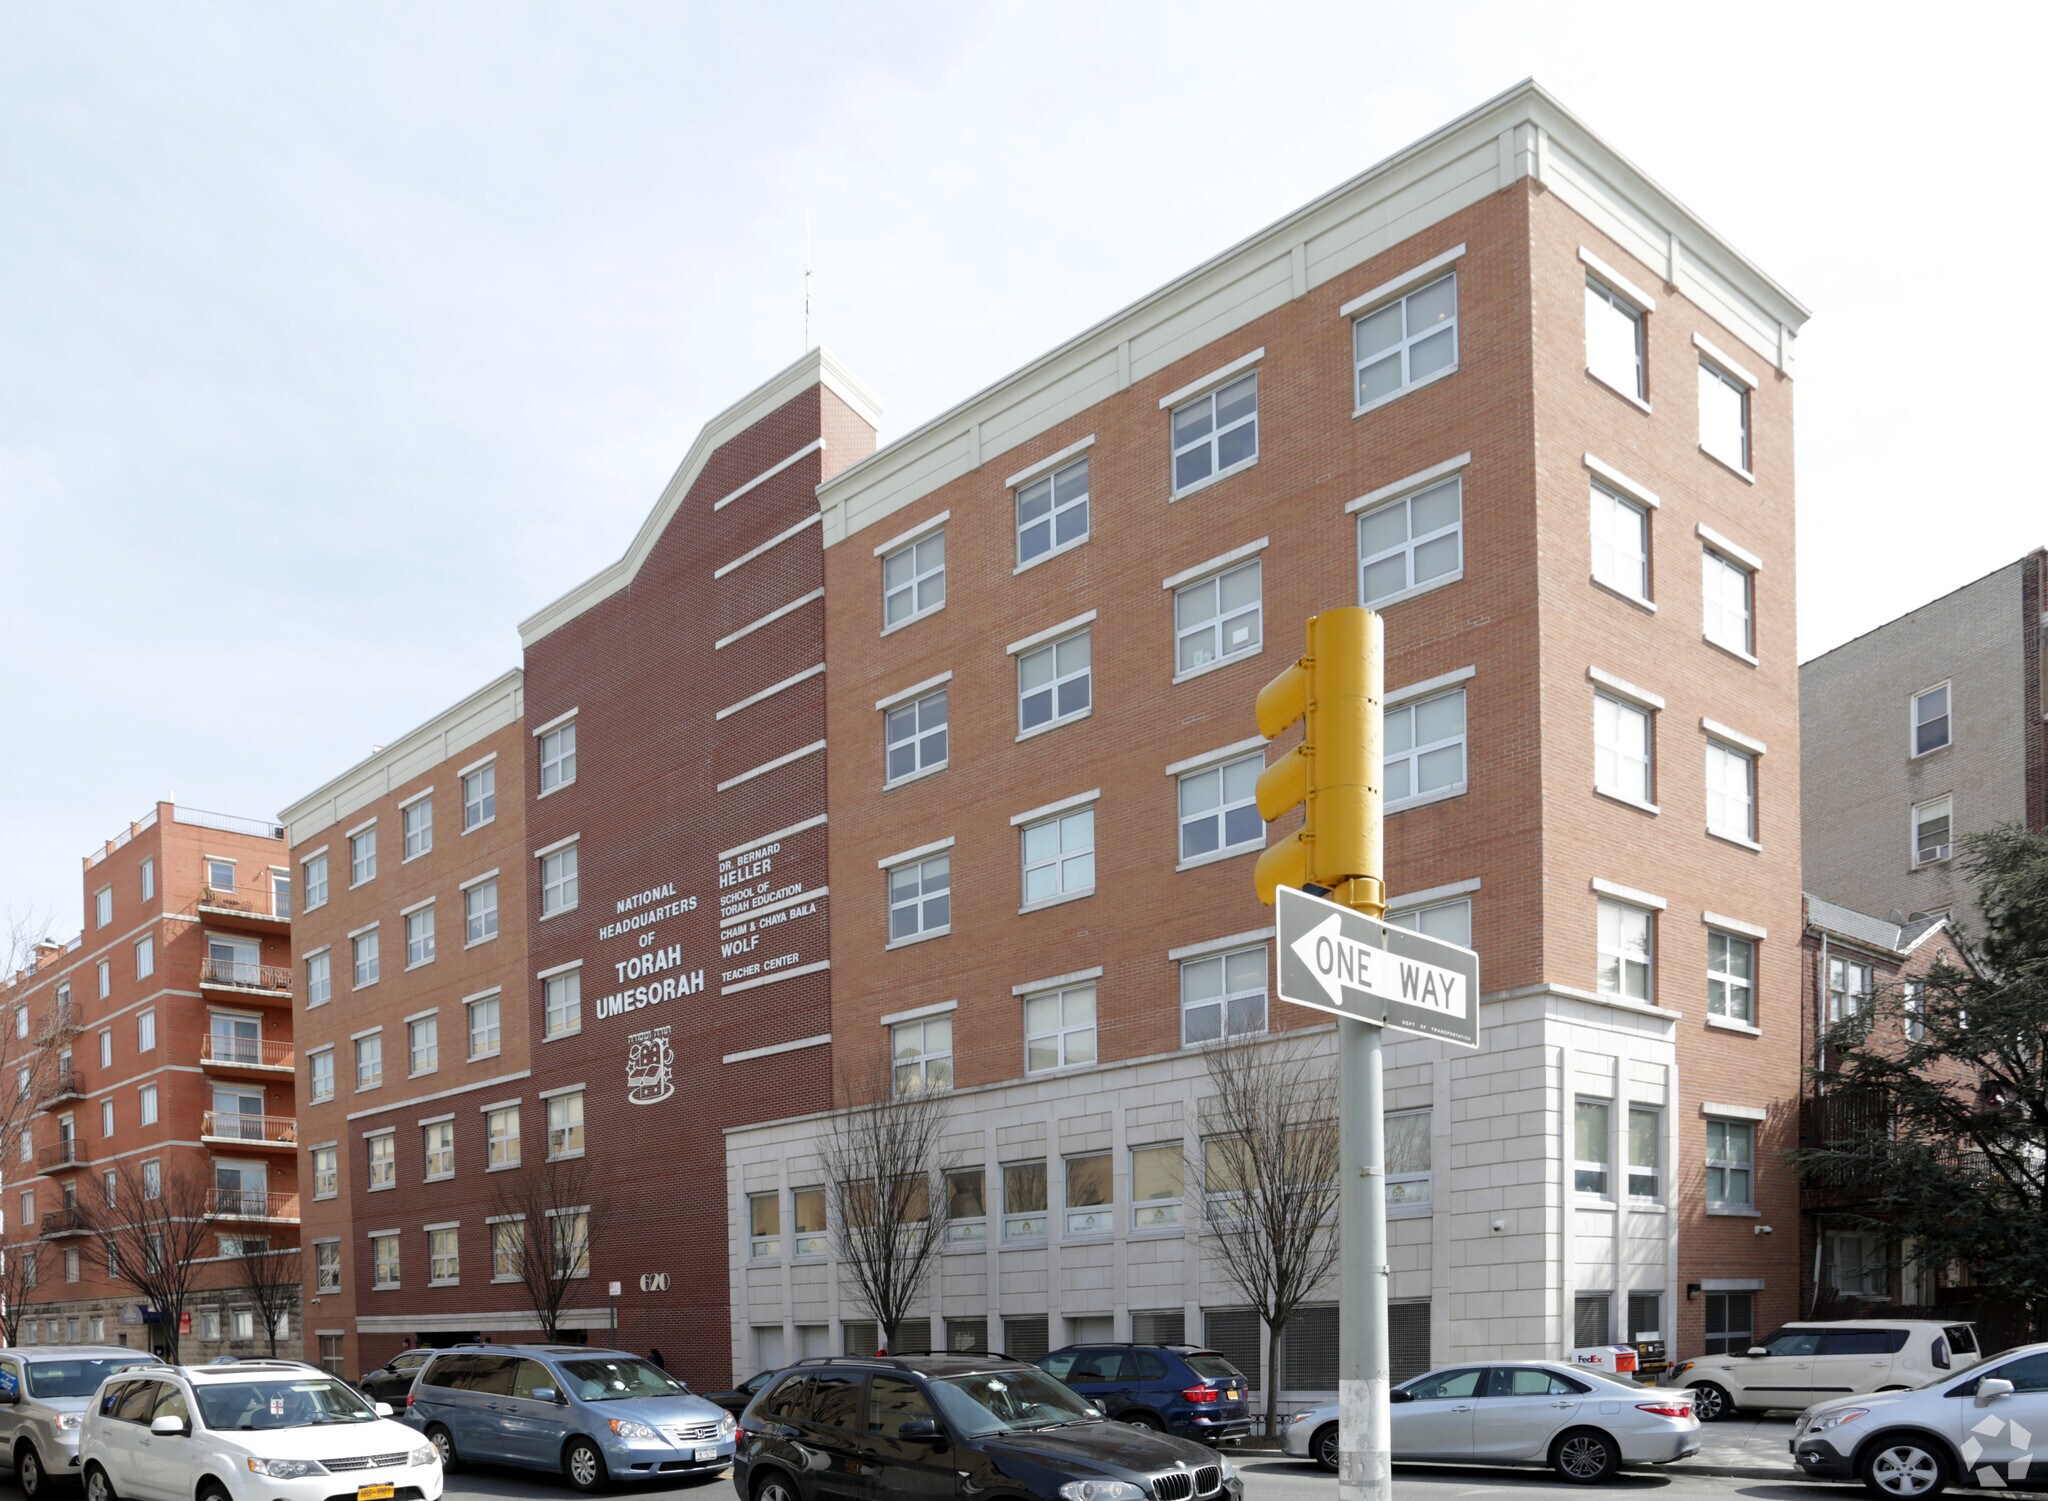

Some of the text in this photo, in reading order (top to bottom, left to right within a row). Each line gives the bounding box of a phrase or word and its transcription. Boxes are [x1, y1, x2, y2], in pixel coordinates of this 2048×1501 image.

[720, 843, 780, 873] DR. BERNARD
[720, 859, 771, 889] HELLER
[617, 882, 676, 914] NATIONAL
[720, 881, 770, 906] SCHOOL OF
[721, 883, 802, 918] TORAH EDUCATION
[600, 896, 697, 940] HEADQUARTERS
[721, 903, 816, 940] CHAIM & CHAYA BAILA
[639, 931, 655, 948] OF
[721, 935, 759, 958] WOLF
[615, 944, 681, 983] TORAH
[722, 953, 799, 982] TEACHER CENTER
[1316, 935, 1455, 1010] ONE WAY
[596, 969, 704, 1019] UMESORAH
[1431, 1026, 1471, 1041] TRANSPORTATION
[640, 1273, 670, 1292] 620
[1578, 1355, 1602, 1364] FedEx
